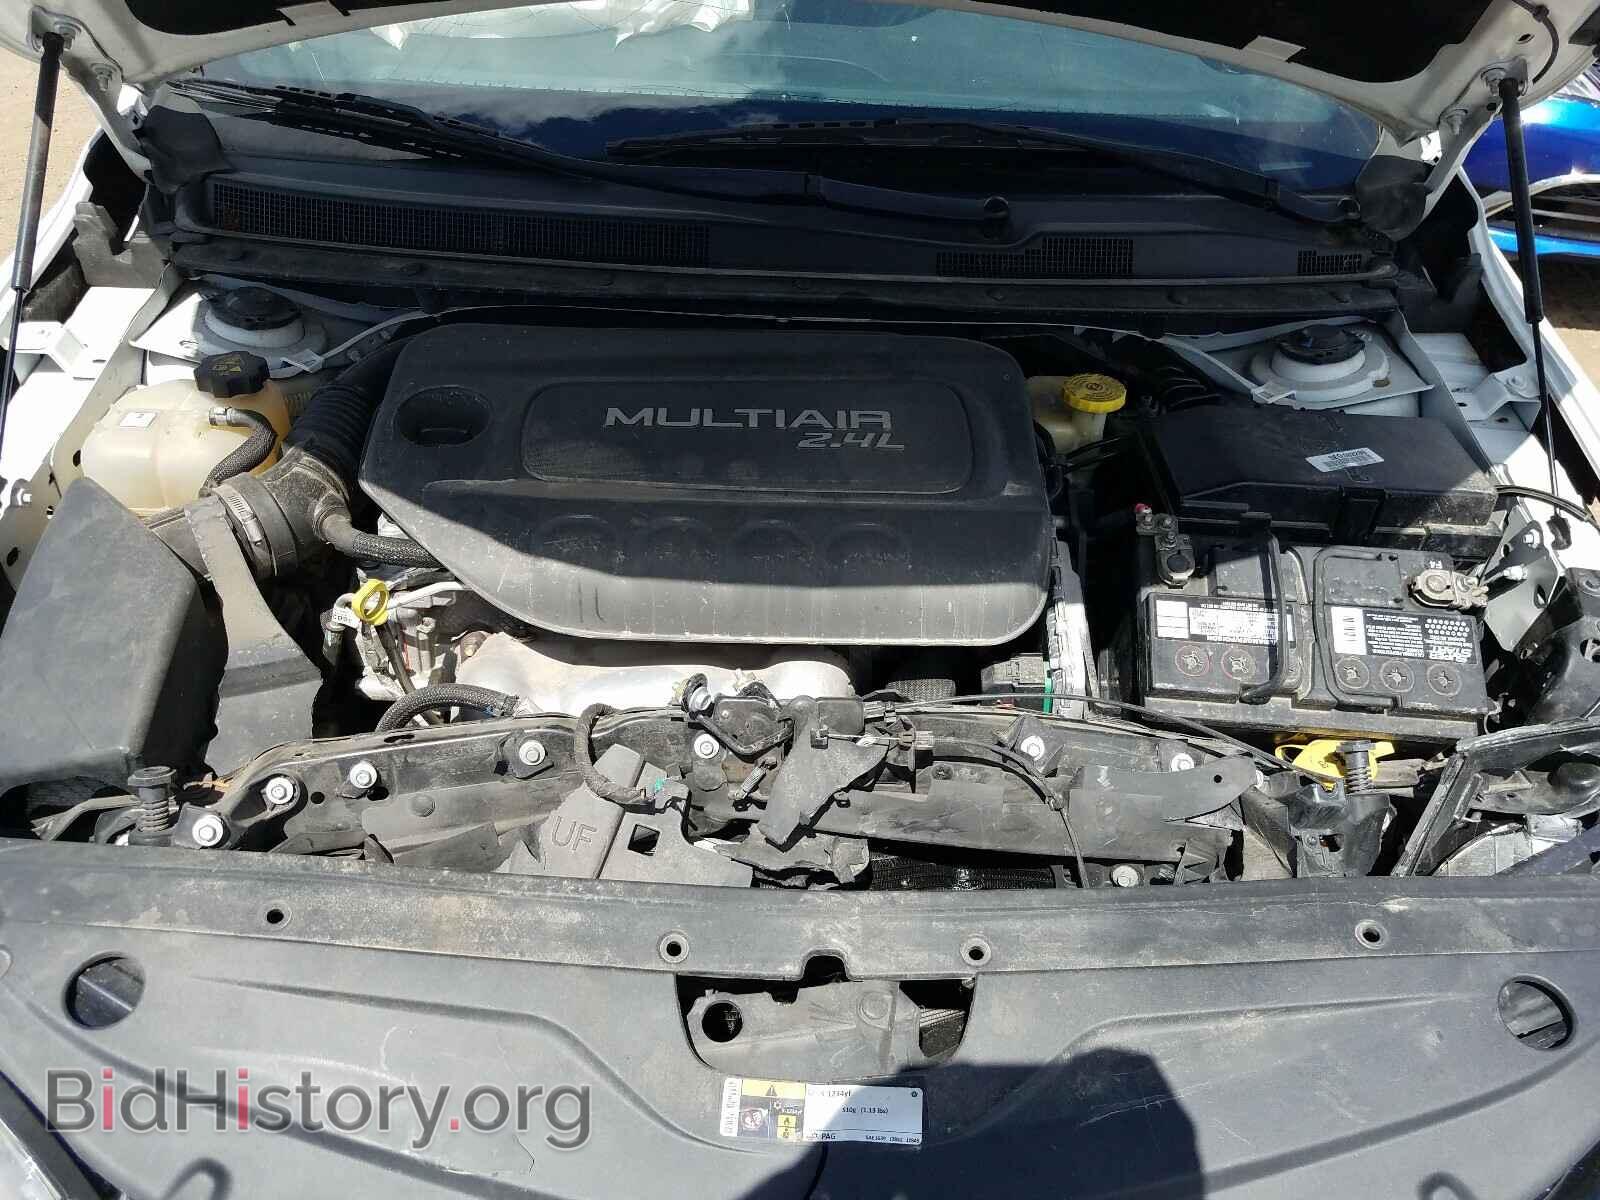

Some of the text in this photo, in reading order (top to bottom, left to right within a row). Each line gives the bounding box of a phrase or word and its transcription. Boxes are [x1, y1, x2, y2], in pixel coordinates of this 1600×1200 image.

[605, 407, 893, 431] MULTIAIR
[797, 432, 905, 450] 2.4L
[552, 815, 597, 851] UF
